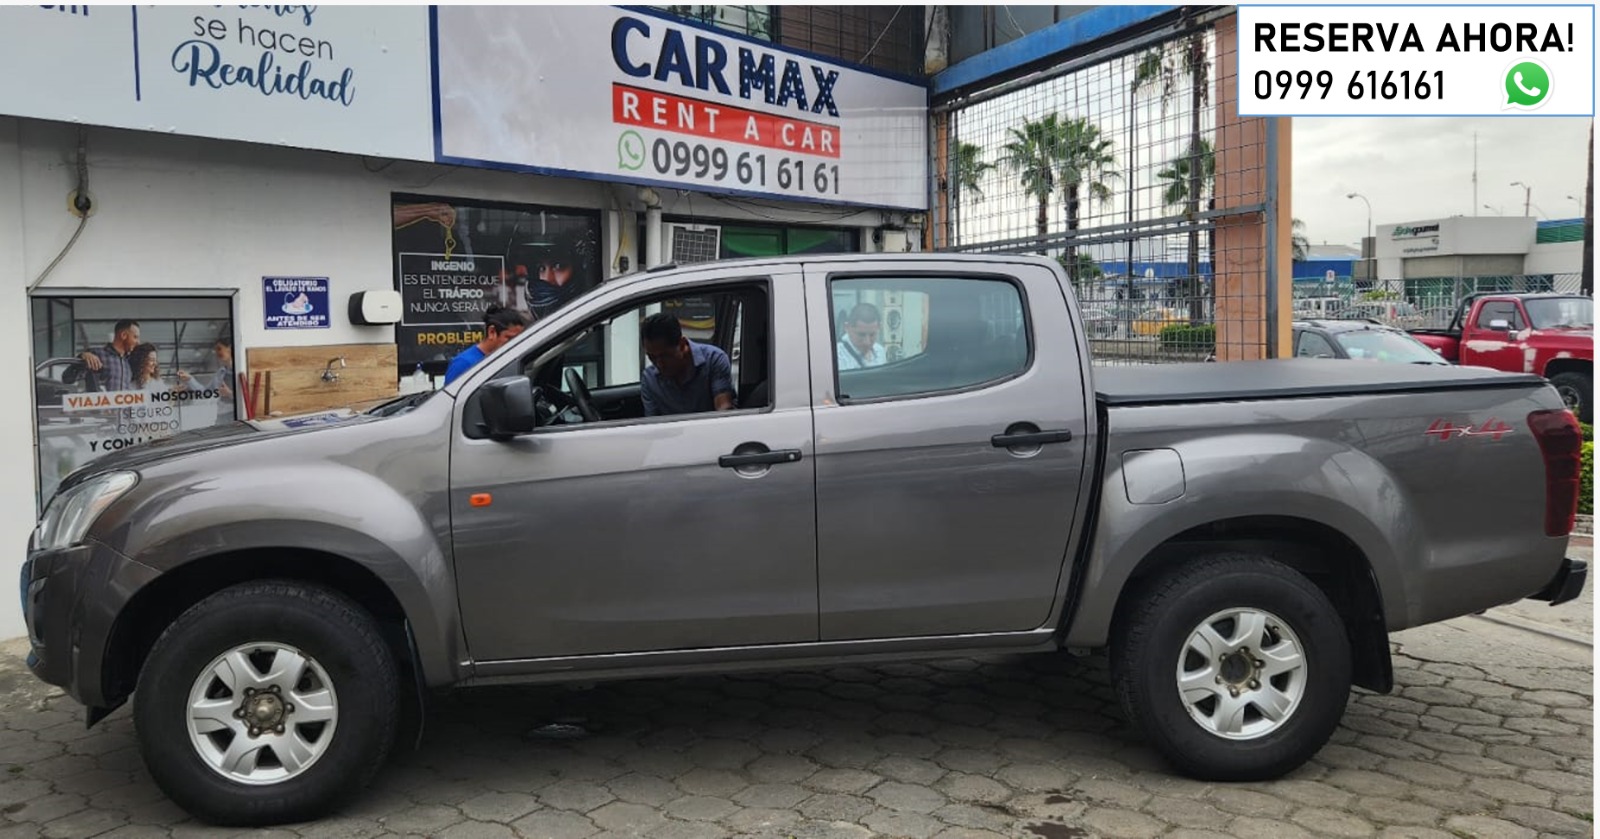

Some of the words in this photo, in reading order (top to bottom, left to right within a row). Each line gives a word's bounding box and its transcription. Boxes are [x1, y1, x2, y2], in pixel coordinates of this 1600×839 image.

[194, 16, 227, 40] se
[239, 18, 333, 60] hacen
[171, 39, 355, 107] Realidad
[611, 16, 732, 96] CAR
[738, 46, 840, 118] MAX
[621, 91, 720, 134] RENT
[744, 116, 760, 141] A
[781, 122, 834, 153] CAR
[652, 137, 728, 182] 0999
[736, 151, 766, 187] 61
[777, 157, 804, 191] 61
[814, 162, 840, 195] 61
[431, 260, 475, 272] INGENIO
[403, 274, 418, 285] ES
[420, 274, 477, 285] ENTENDER
[478, 275, 500, 286] QUE
[423, 288, 437, 299] EL
[438, 286, 484, 299] TRÁFICO
[411, 302, 450, 313] NUNCA
[68, 395, 110, 409] VIAJA
[114, 394, 144, 405] CON
[151, 389, 220, 402] NOSOTROS
[122, 406, 172, 419] SEGURO
[89, 441, 98, 452] Y
[102, 438, 134, 451] CON
